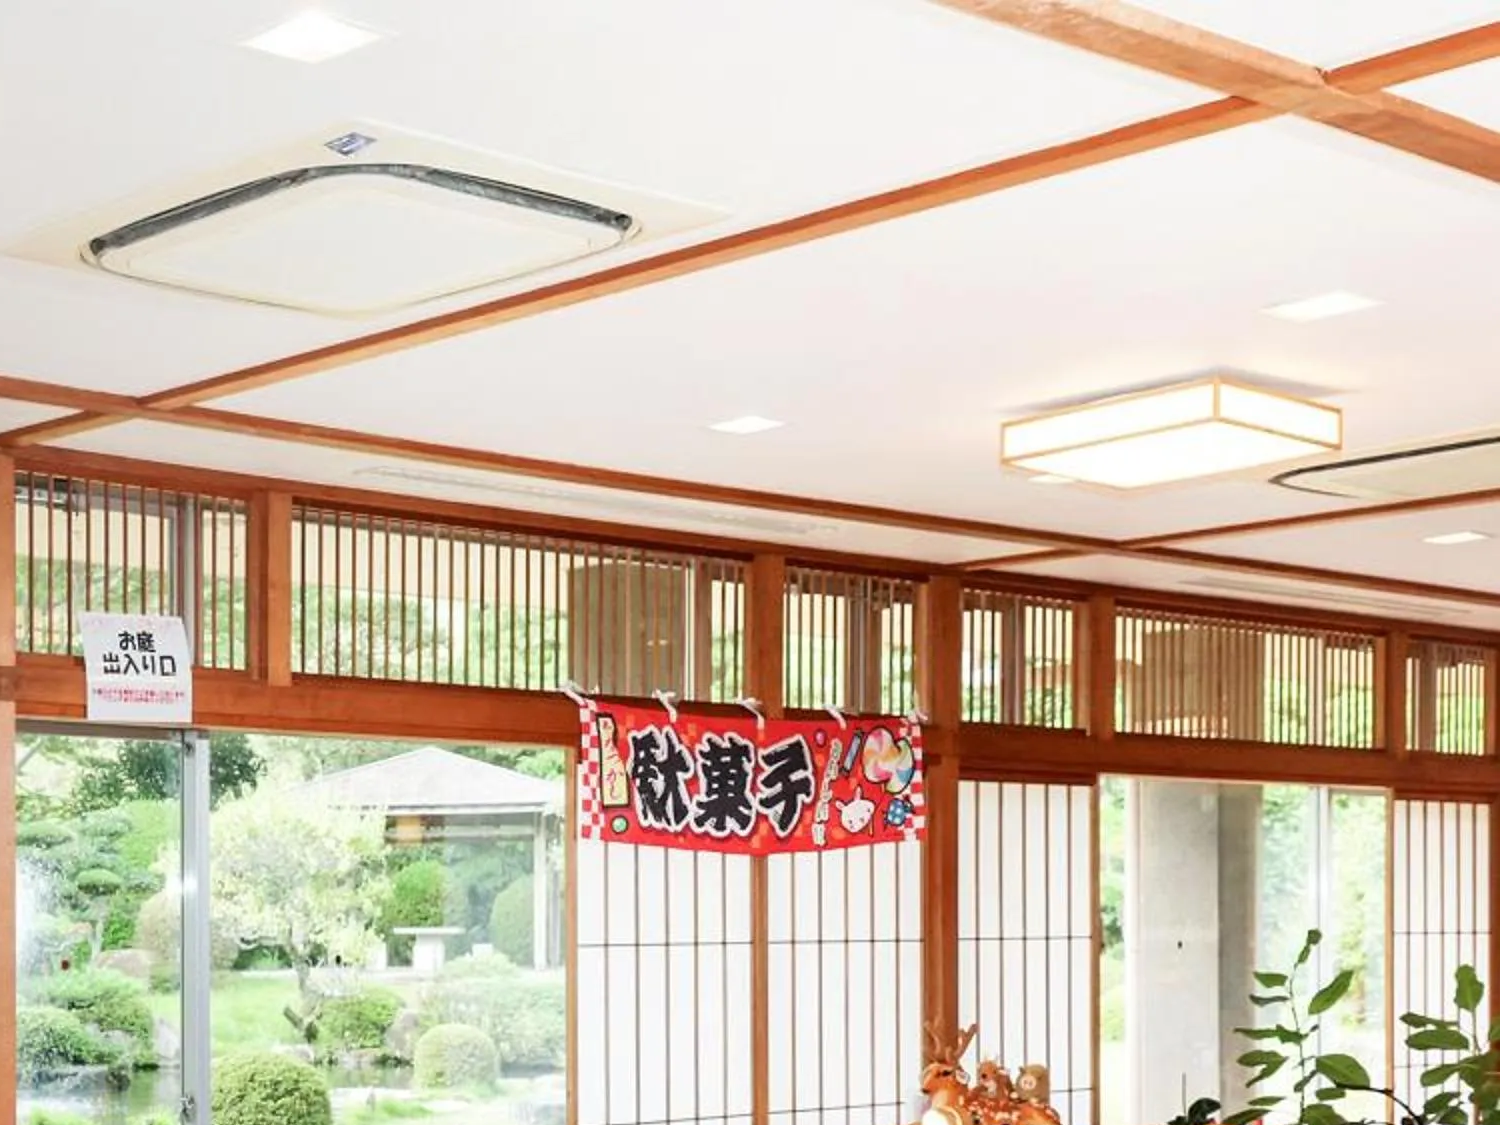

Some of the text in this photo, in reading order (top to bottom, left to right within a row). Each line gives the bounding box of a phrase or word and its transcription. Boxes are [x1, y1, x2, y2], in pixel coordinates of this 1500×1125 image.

[118, 631, 156, 652] お庭
[103, 652, 176, 676] 出入り口
[630, 727, 812, 834] 駄菓子
